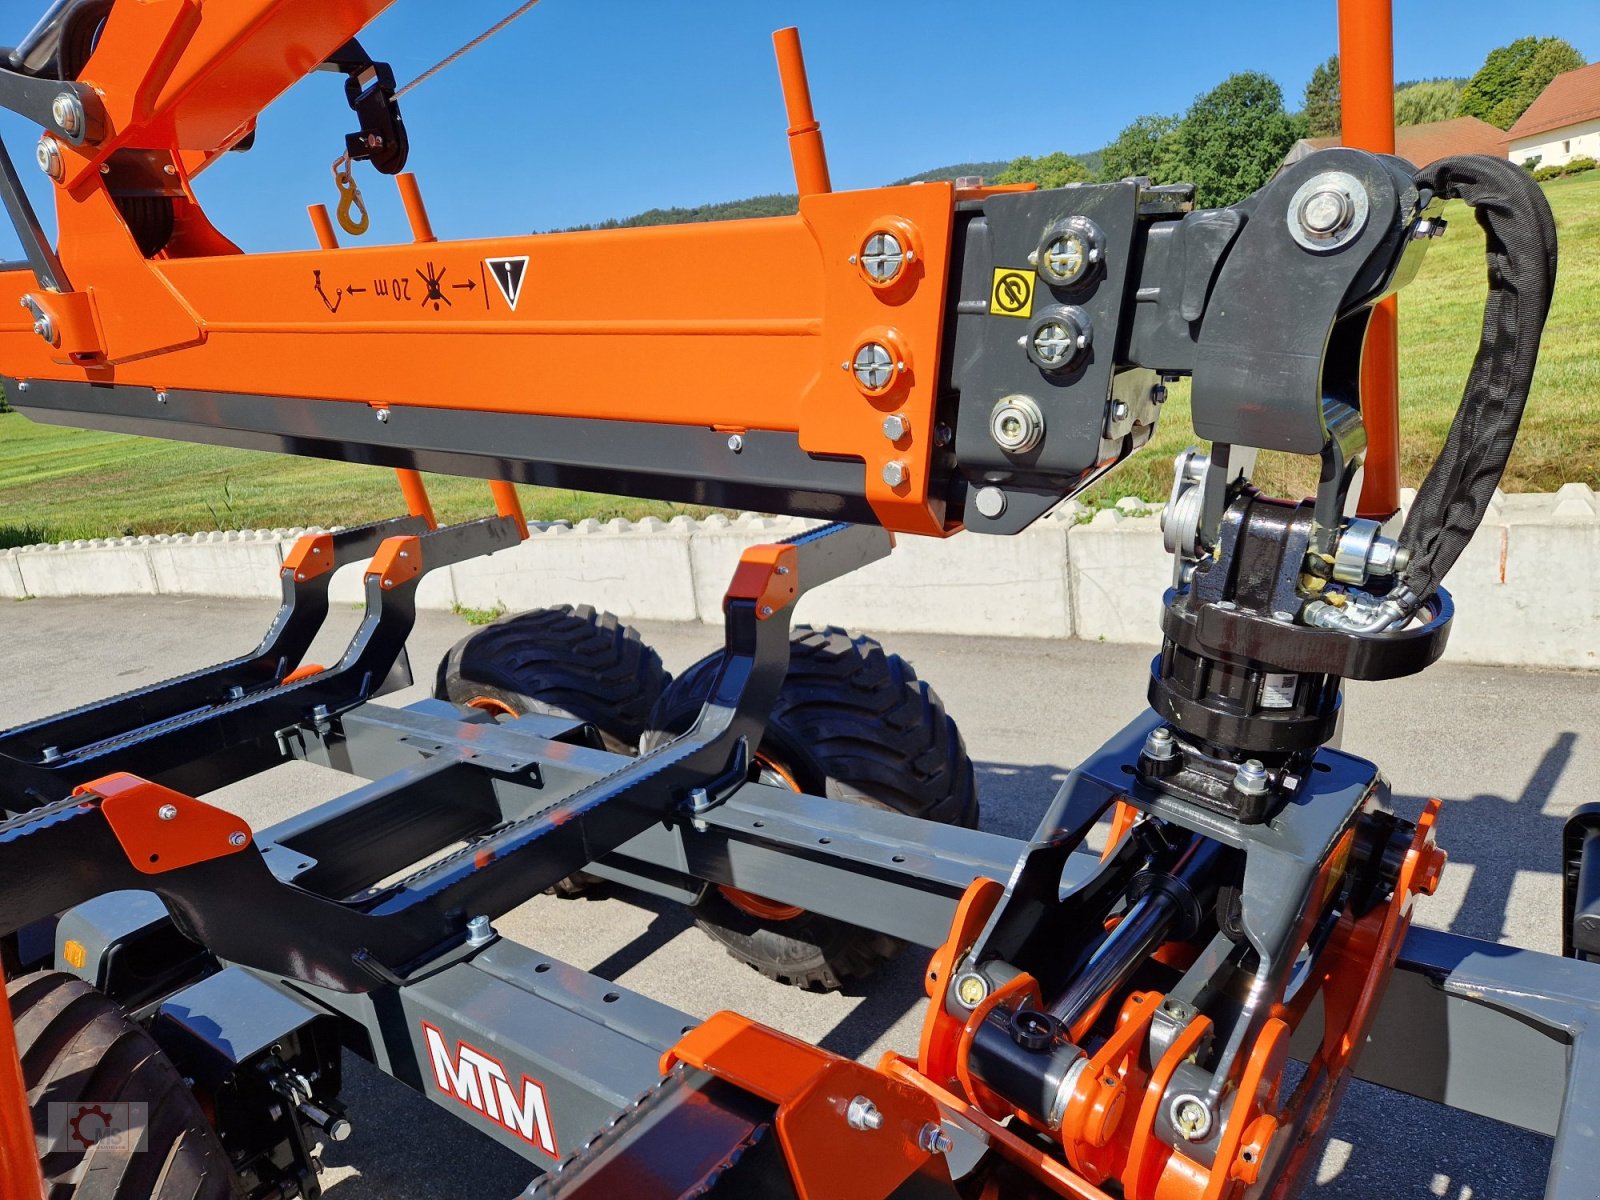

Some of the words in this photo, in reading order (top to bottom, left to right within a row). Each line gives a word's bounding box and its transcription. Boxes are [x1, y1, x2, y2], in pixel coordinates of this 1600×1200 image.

[373, 279, 389, 296] m
[392, 278, 412, 301] 20
[422, 1022, 558, 1157] MTM
